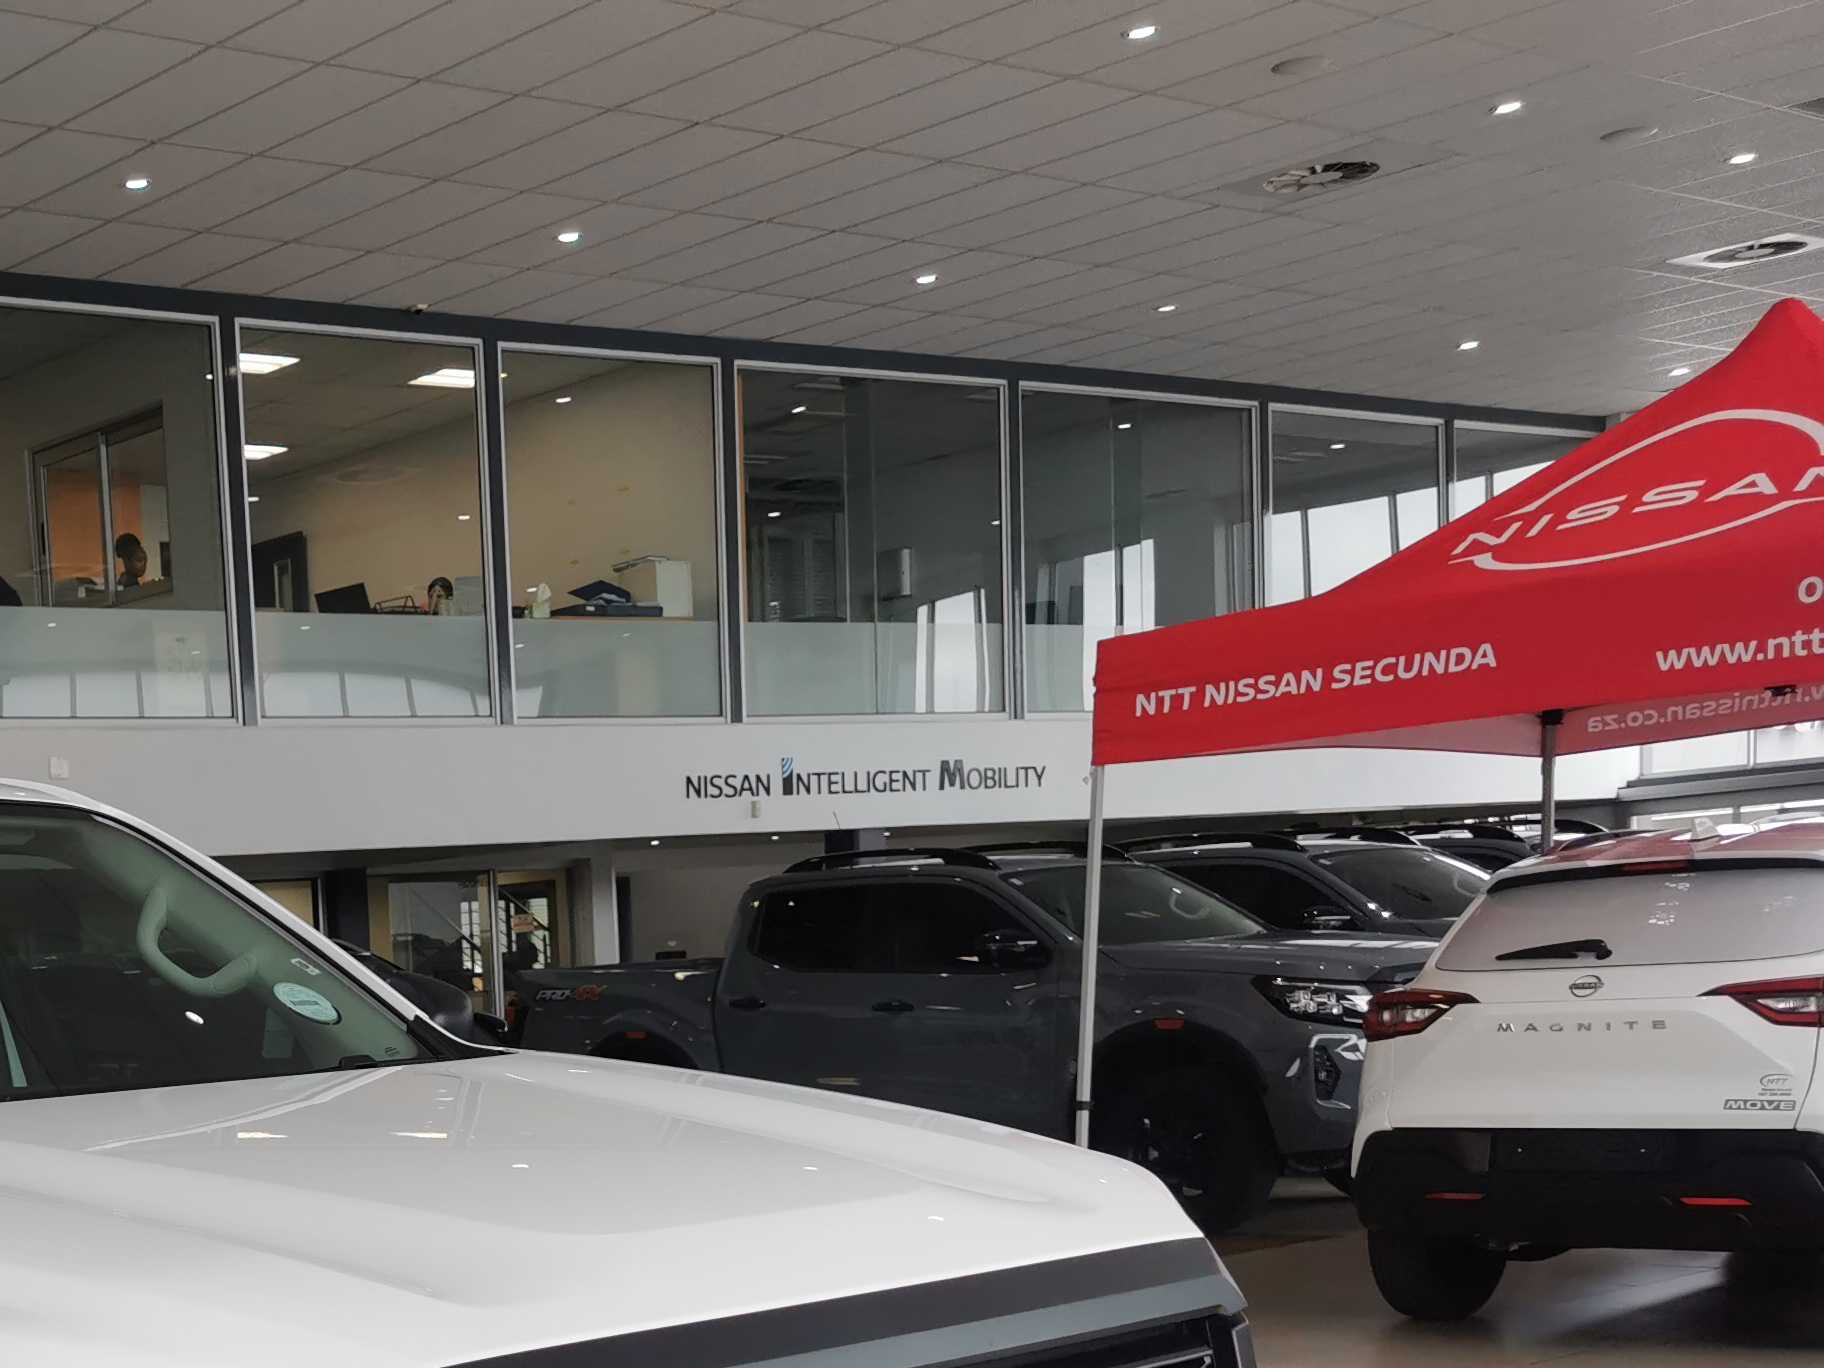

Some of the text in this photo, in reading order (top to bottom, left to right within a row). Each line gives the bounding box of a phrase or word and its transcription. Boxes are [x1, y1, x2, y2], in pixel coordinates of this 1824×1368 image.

[1134, 642, 1497, 718] NTT NISSAN SECUNDA
[685, 757, 1046, 799] NISSAN INTELLIGENT MOBILITY
[1497, 1019, 1667, 1032] MAGNITE
[1725, 1100, 1795, 1110] MOVE
